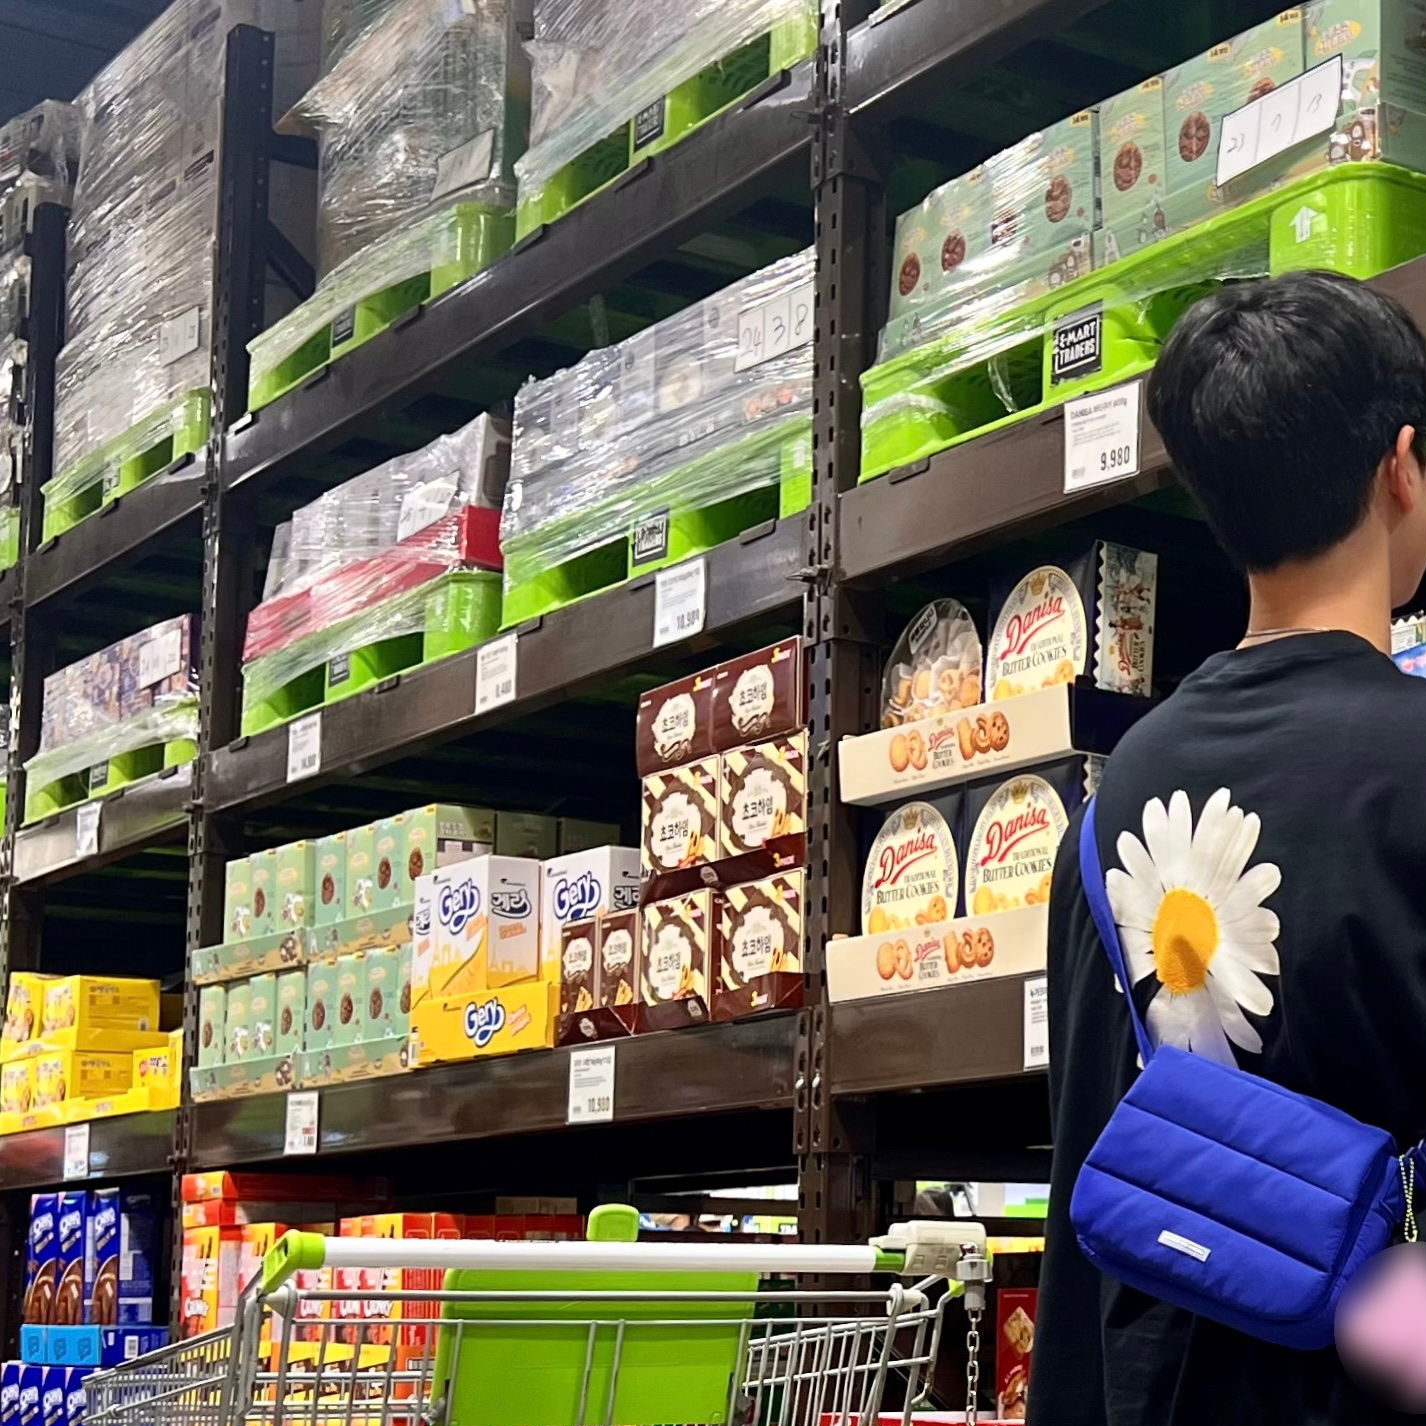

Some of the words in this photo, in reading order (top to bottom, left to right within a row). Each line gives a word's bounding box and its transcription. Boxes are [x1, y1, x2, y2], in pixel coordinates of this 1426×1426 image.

[772, 315, 785, 345] 3
[795, 303, 809, 336] 8
[1059, 320, 1097, 349] E-MART
[1059, 340, 1097, 366] TRADERS
[1100, 445, 1131, 472] 9,980
[999, 592, 1066, 661] Danisa
[1002, 654, 1031, 678] BUTTER
[1032, 645, 1068, 668] COOKIES
[739, 683, 767, 706] 초코하임
[662, 711, 689, 733] 초코하임
[742, 796, 773, 820] 초코하임
[659, 820, 689, 842] 초코하임
[980, 802, 1050, 867] Danisa
[874, 828, 938, 889] Danisa
[983, 865, 1014, 884] BUTTER
[1015, 857, 1052, 878] COOKIES
[440, 877, 481, 935] Gery
[553, 871, 602, 923] Gery
[876, 886, 905, 905] BUTTER
[906, 882, 940, 899] COOKIES
[741, 934, 772, 956] 초코하임
[656, 950, 682, 972] 초코하임
[464, 996, 506, 1047] Gery
